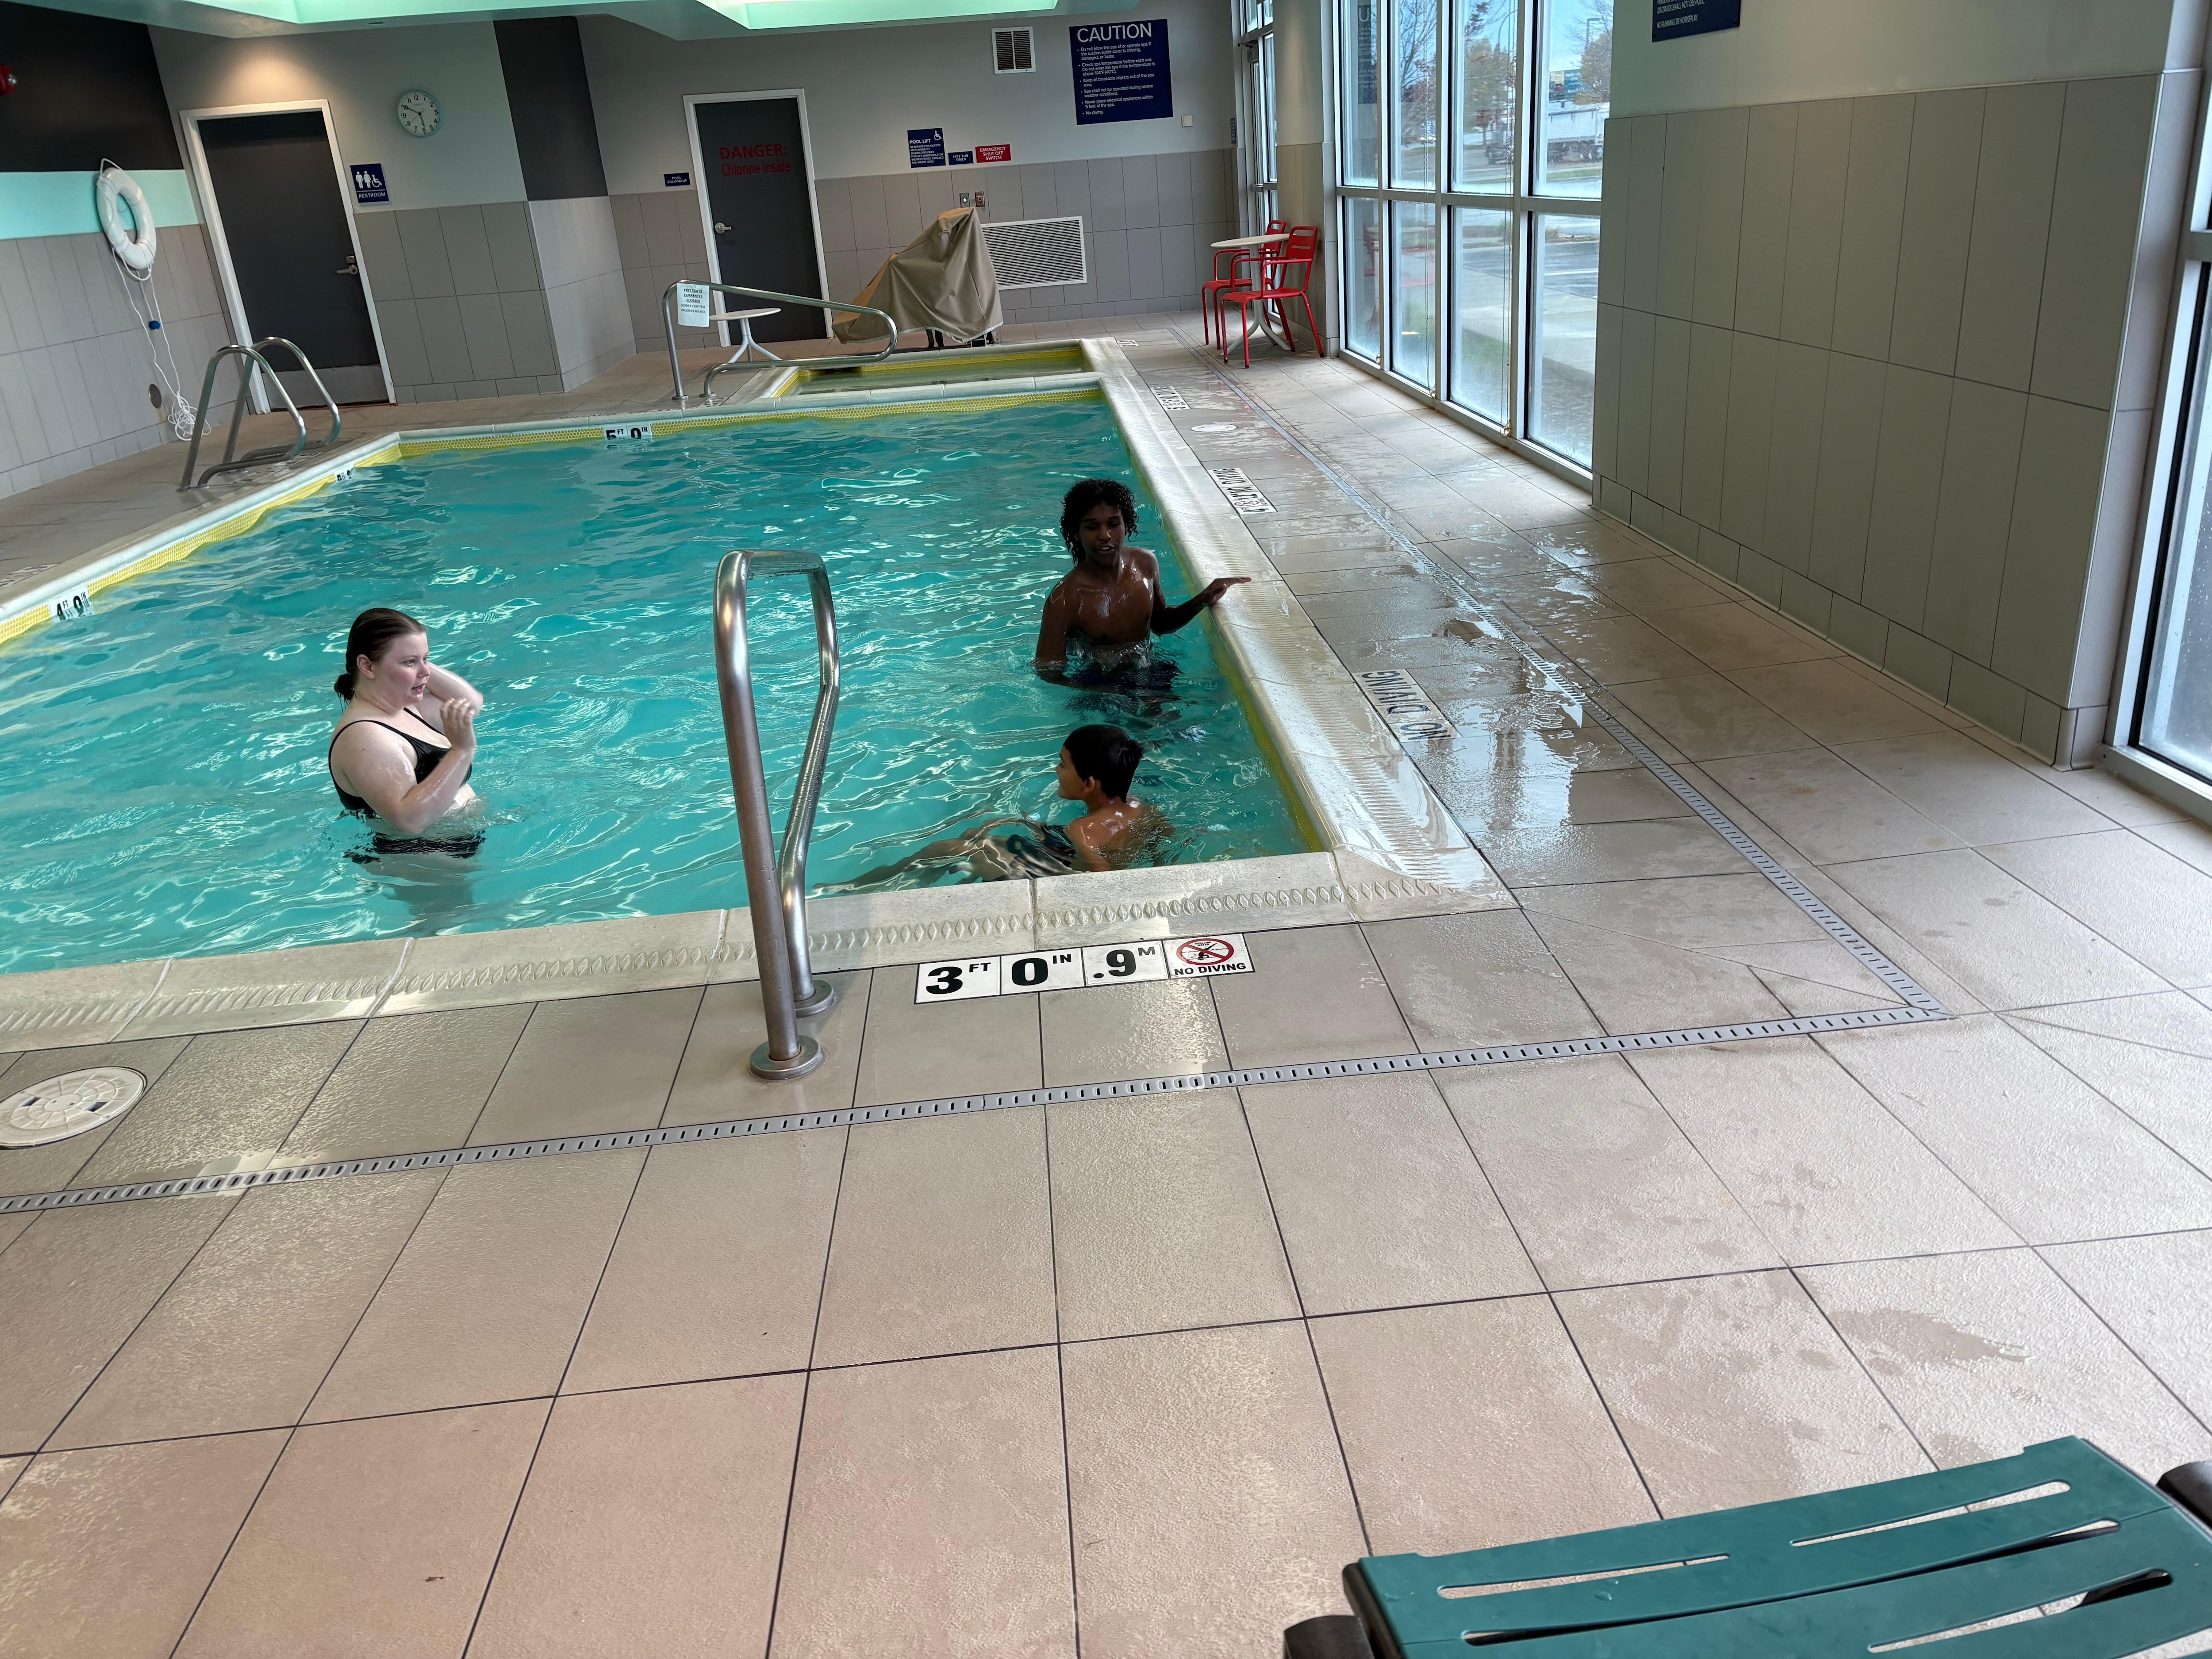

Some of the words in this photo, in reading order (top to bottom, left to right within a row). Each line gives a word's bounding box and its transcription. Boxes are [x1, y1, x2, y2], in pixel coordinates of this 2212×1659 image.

[1077, 23, 1152, 42] CAUTION
[719, 143, 787, 160] DANGER:
[722, 163, 760, 177] Chlorine
[763, 160, 790, 173] Inside
[606, 430, 617, 440] 5
[630, 428, 641, 439] 0
[1212, 469, 1246, 484] DIVING
[62, 600, 69, 609] FT
[73, 595, 84, 611] 0
[1362, 671, 1430, 714] DIVING
[1400, 722, 1451, 740] NO
[926, 966, 963, 995] 3
[969, 963, 991, 972] FT
[1011, 958, 1048, 986] 0
[1053, 954, 1071, 964] IN
[1093, 949, 1136, 979] .9
[1138, 947, 1156, 956] M
[1198, 963, 1246, 973] DIVING
